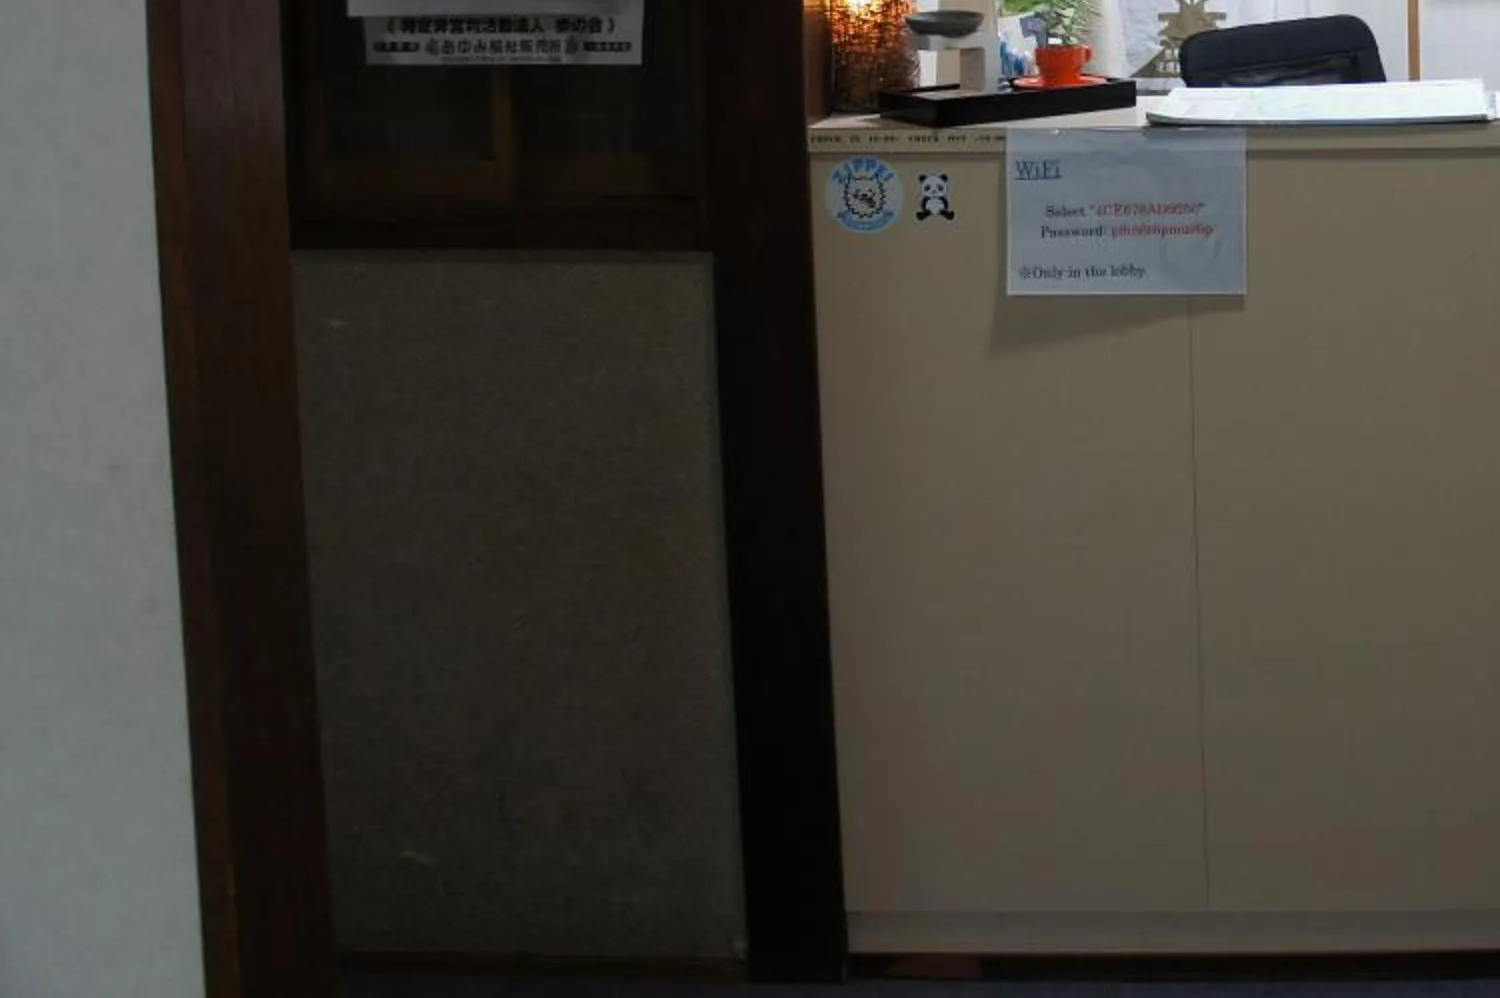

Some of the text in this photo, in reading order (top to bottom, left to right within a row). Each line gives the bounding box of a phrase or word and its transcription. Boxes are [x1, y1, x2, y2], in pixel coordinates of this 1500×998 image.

[1015, 159, 1062, 179] WiFi
[1045, 204, 1086, 217] Select
[1068, 266, 1082, 278] in
[1085, 264, 1106, 277] the
